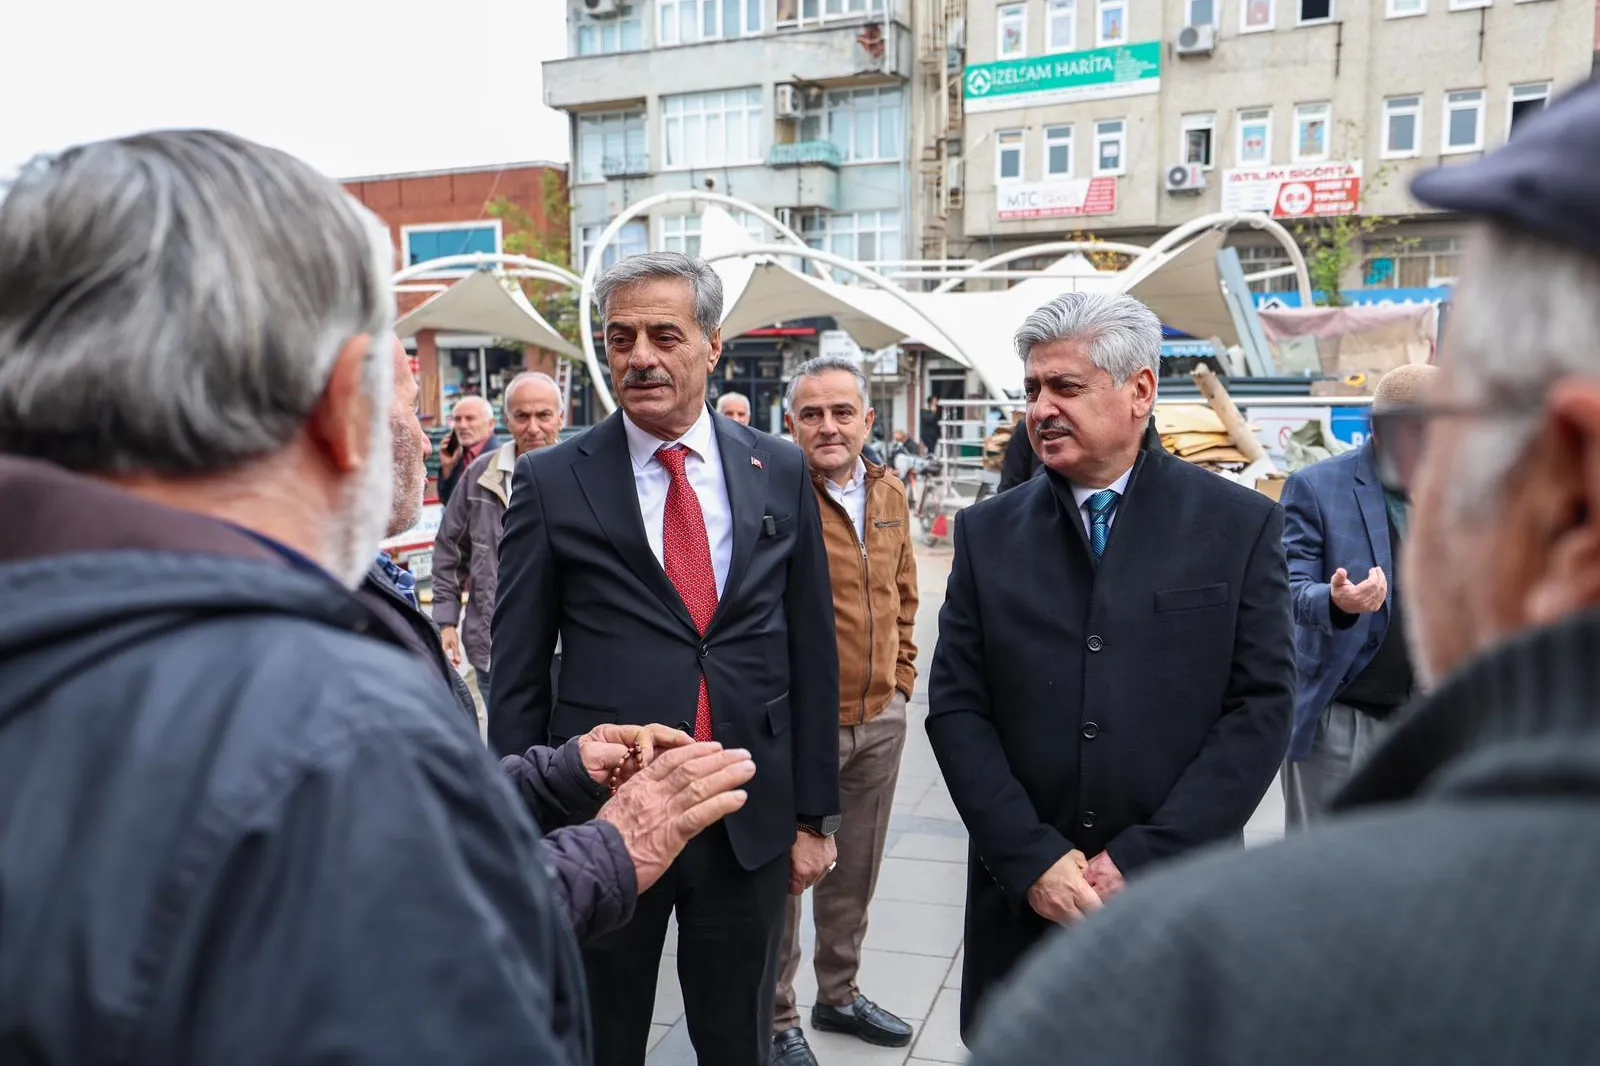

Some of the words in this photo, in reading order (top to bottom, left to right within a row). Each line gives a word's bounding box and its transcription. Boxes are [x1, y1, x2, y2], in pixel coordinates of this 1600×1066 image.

[1055, 54, 1114, 78] HARİTA
[1231, 170, 1285, 182] ATILIM
[1007, 191, 1039, 207] MTC
